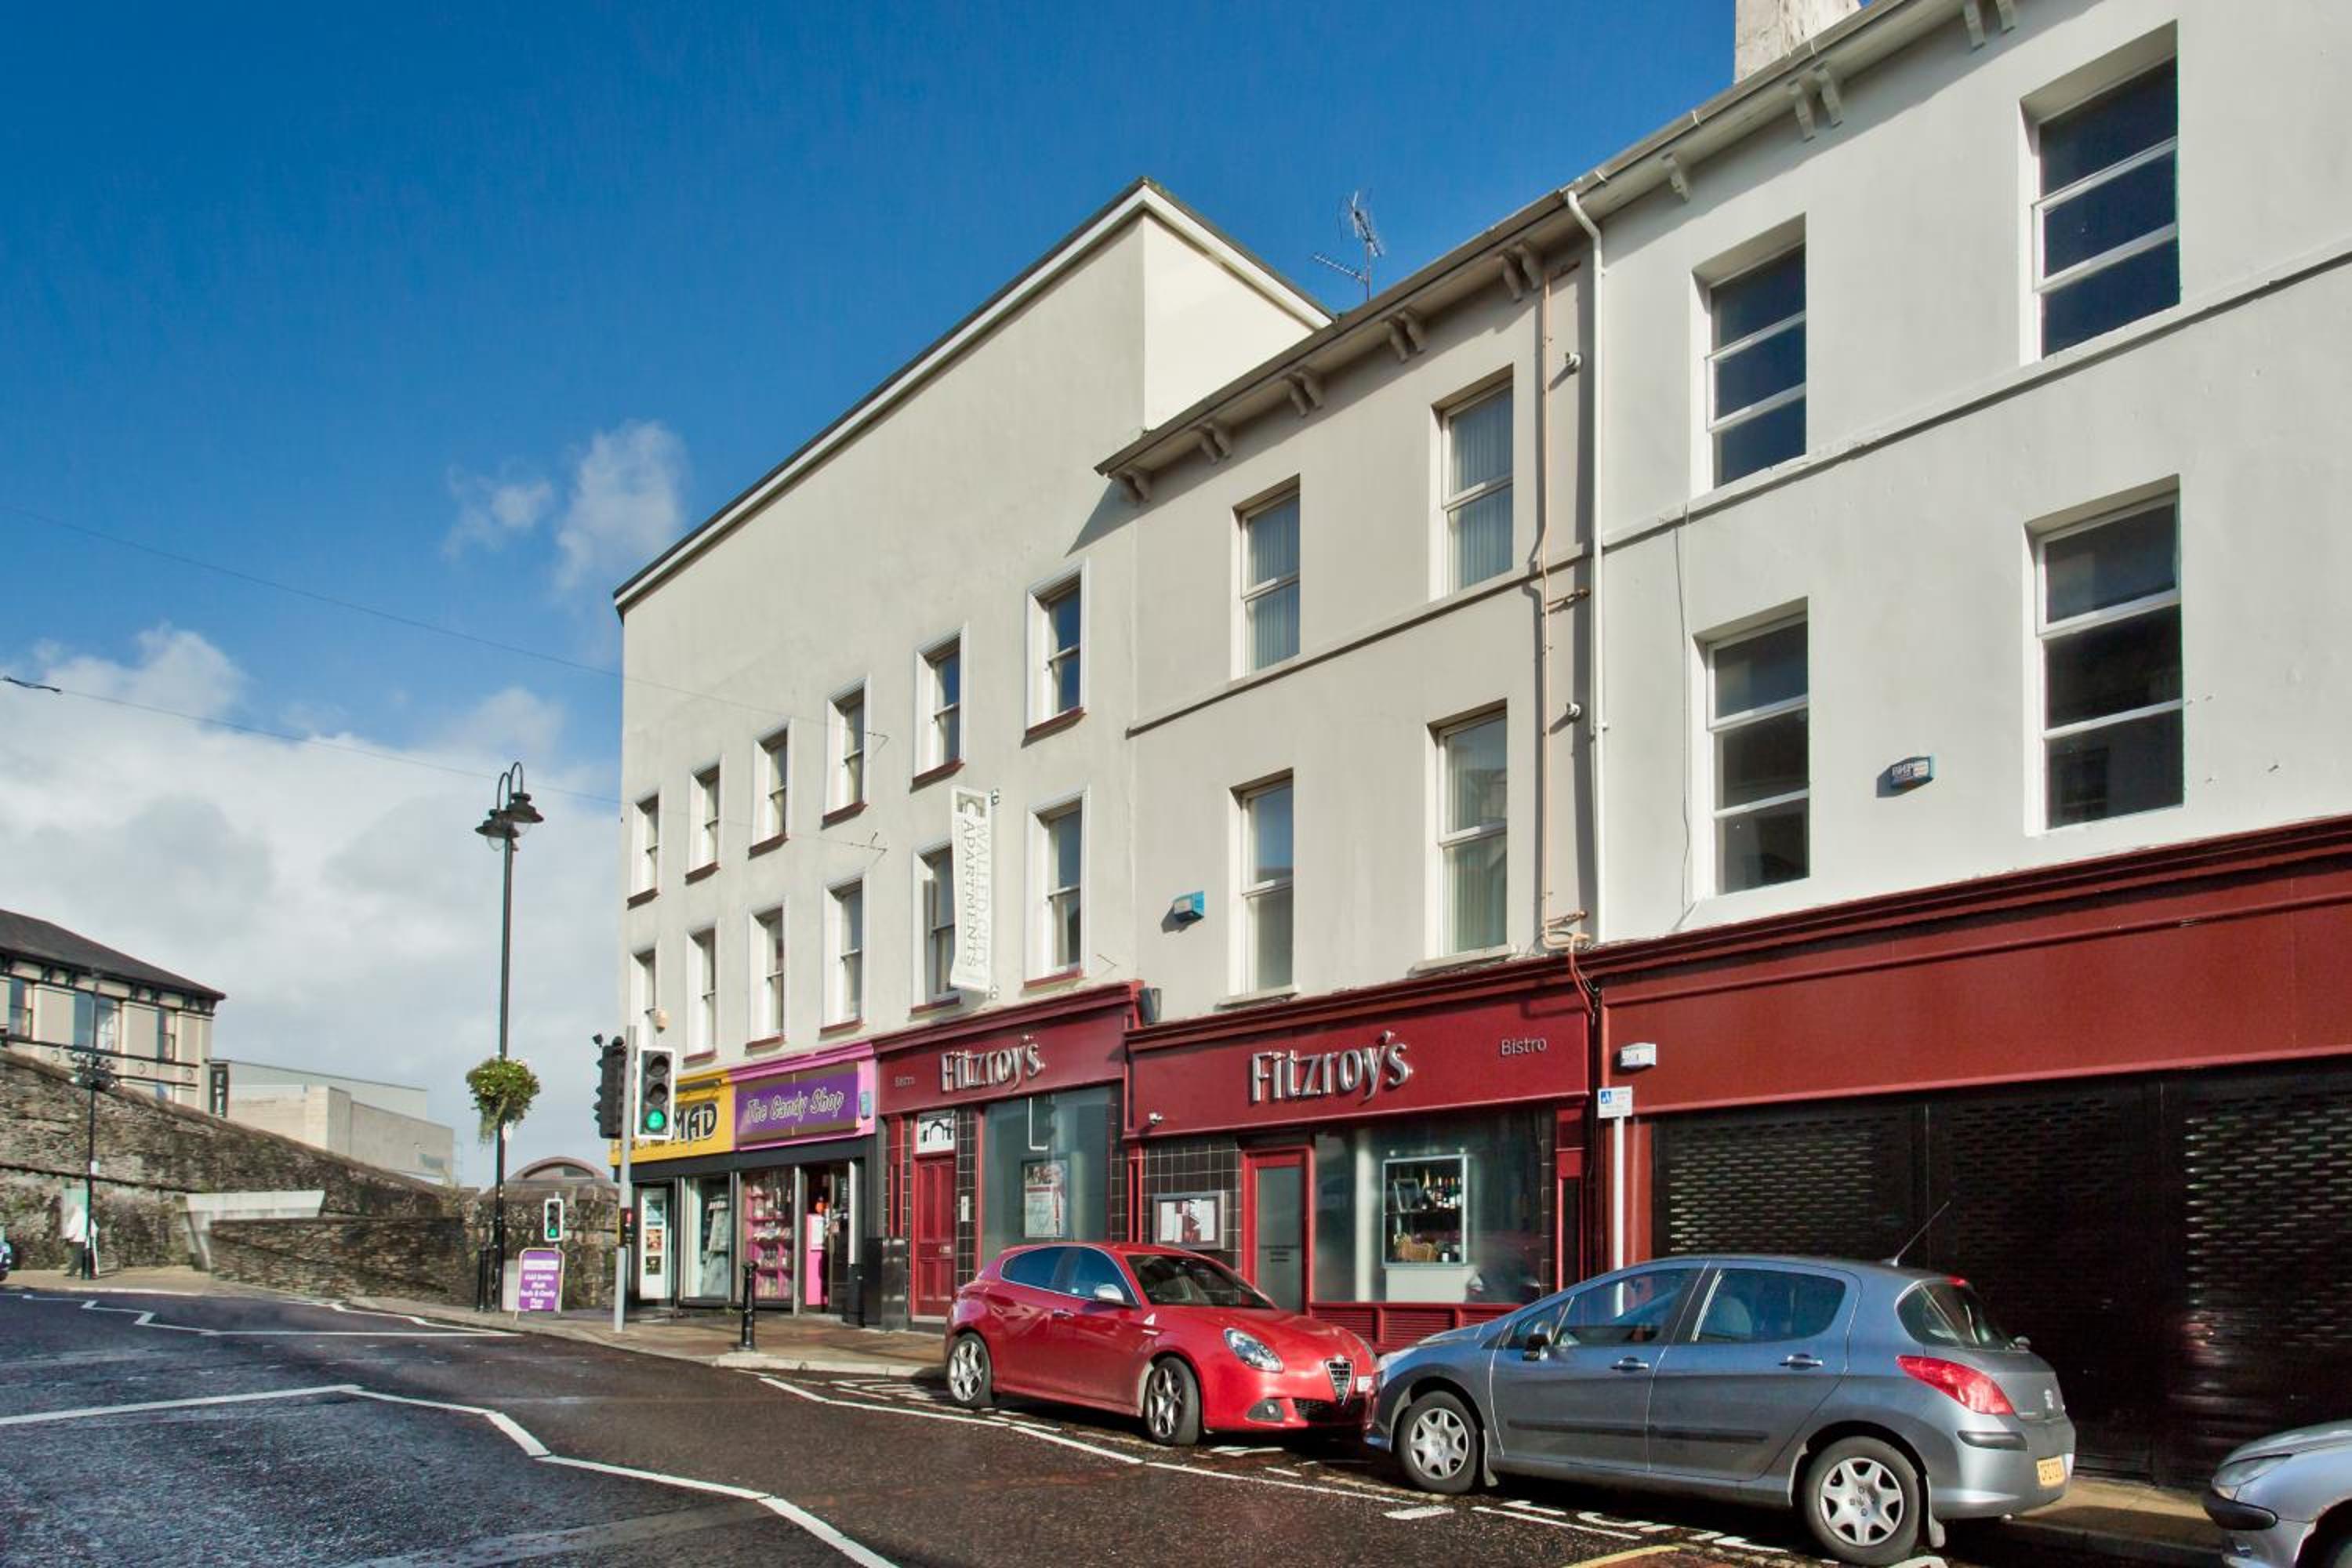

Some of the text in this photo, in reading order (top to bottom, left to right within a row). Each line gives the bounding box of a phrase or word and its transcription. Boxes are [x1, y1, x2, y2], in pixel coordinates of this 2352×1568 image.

[964, 818, 978, 967] APARTMENTS
[941, 1034, 1047, 1092] Fitzroy's
[1252, 1029, 1412, 1102] Fitzroy's
[1501, 1037, 1547, 1055] Bistro
[747, 1087, 844, 1123] The Candy Shop
